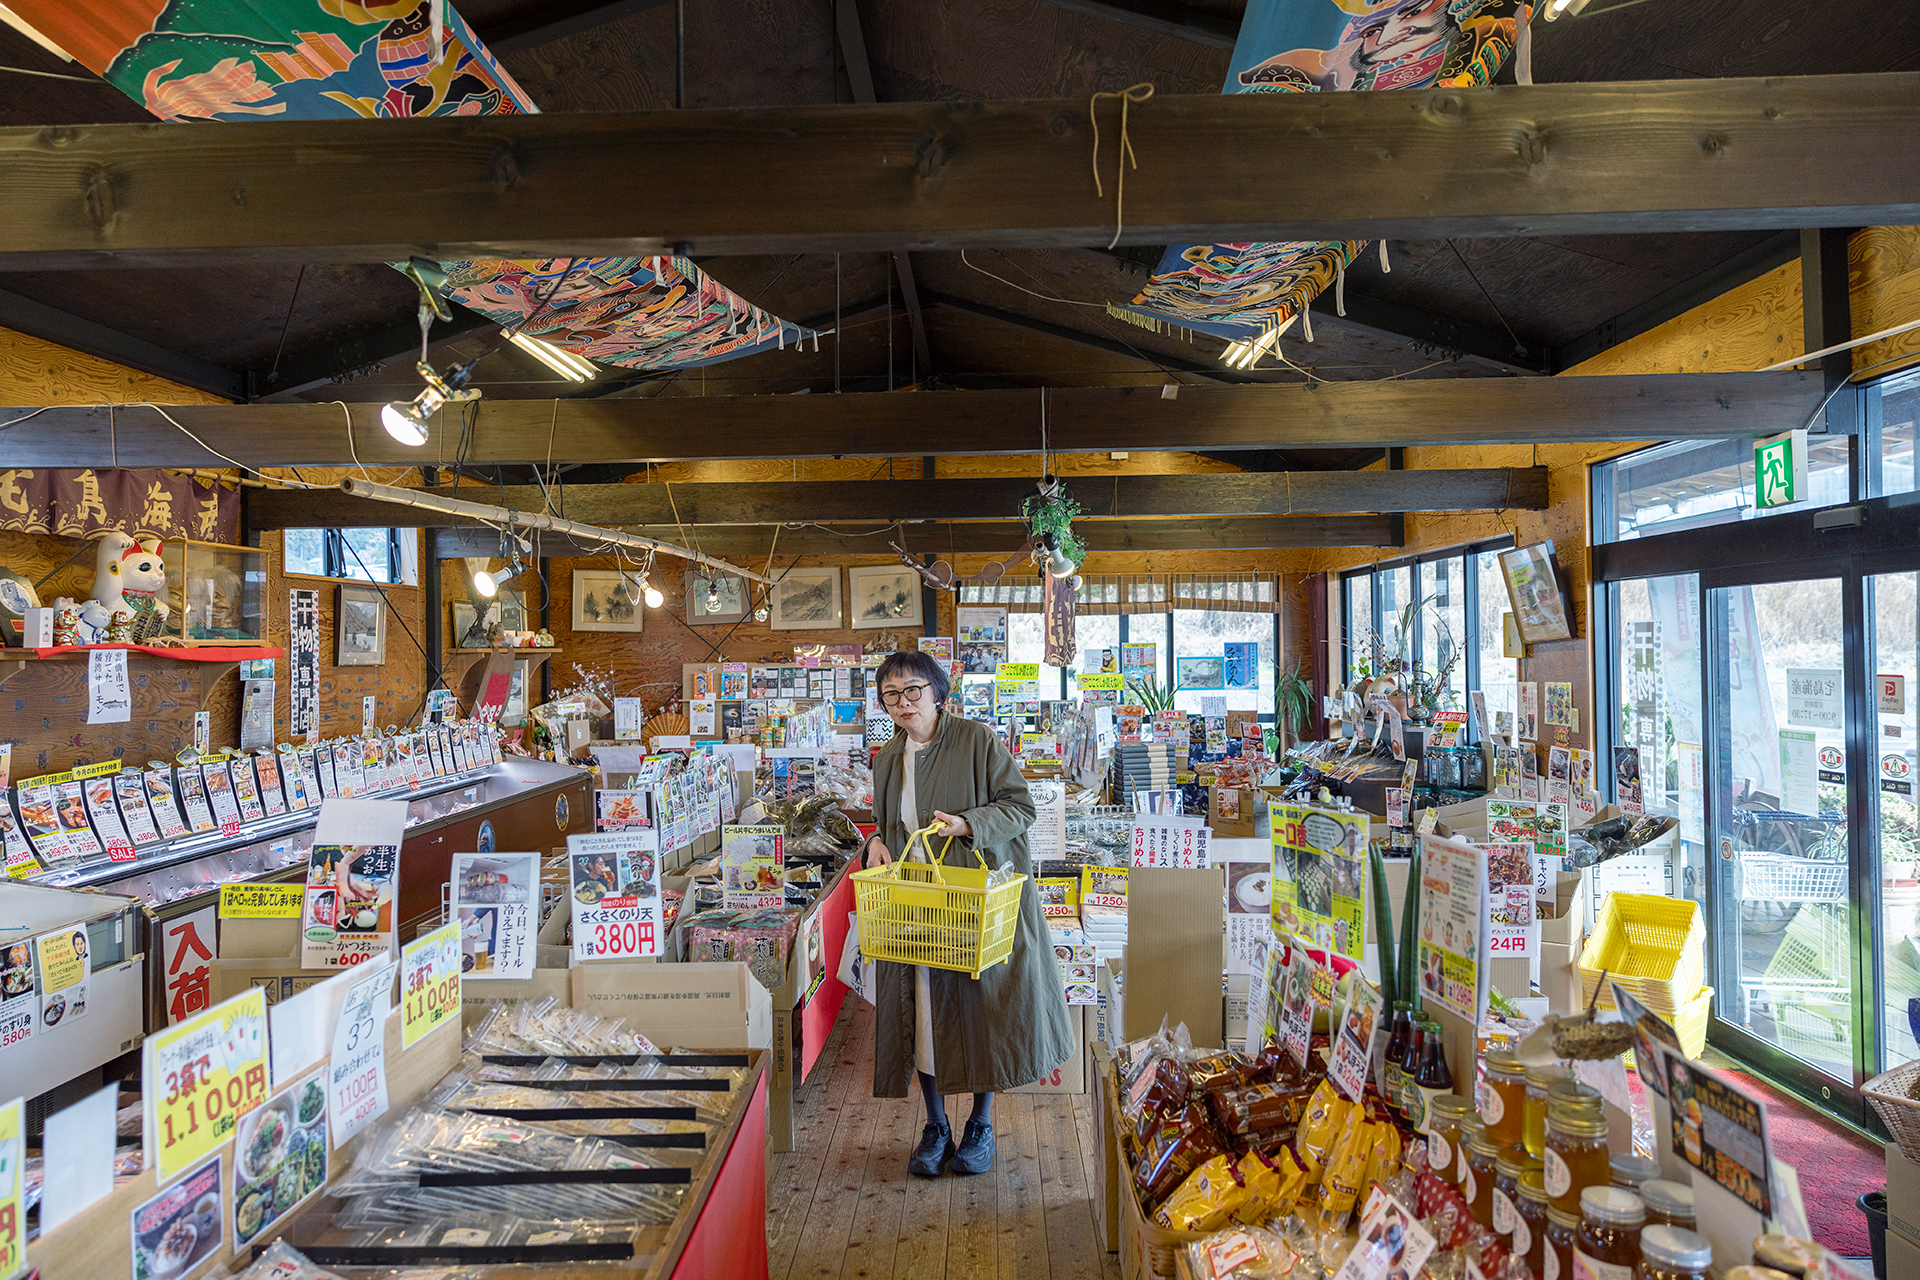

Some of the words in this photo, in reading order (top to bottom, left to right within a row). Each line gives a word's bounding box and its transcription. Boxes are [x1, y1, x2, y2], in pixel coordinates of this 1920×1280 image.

[104, 652, 113, 683] 育てた
[297, 597, 314, 731] 干物専門店
[222, 822, 239, 836] SALE
[1274, 822, 1307, 848] 一口香
[1491, 825, 1540, 839] バラちゃん
[107, 839, 128, 849] 380円
[111, 847, 135, 859] SALE
[1539, 845, 1567, 857] 324円
[7, 851, 31, 865] 890円
[362, 847, 376, 875] かつお
[375, 846, 389, 873] 半生
[1537, 858, 1547, 895] キャベツの
[758, 896, 782, 908] 432円
[1096, 895, 1128, 907] 1250円
[580, 907, 654, 923] さくさくのり天
[500, 904, 515, 973] 冷えてます?
[513, 904, 529, 969] 今日、ビール
[169, 921, 213, 1027] 入荷
[407, 962, 433, 997] 3袋で
[347, 971, 392, 1009] おつまみ
[3, 1028, 31, 1047] 580円
[346, 1017, 375, 1052] 3つ
[165, 1053, 211, 1106] 3袋で
[338, 1067, 378, 1109] 1100円
[355, 1097, 378, 1121] 400円
